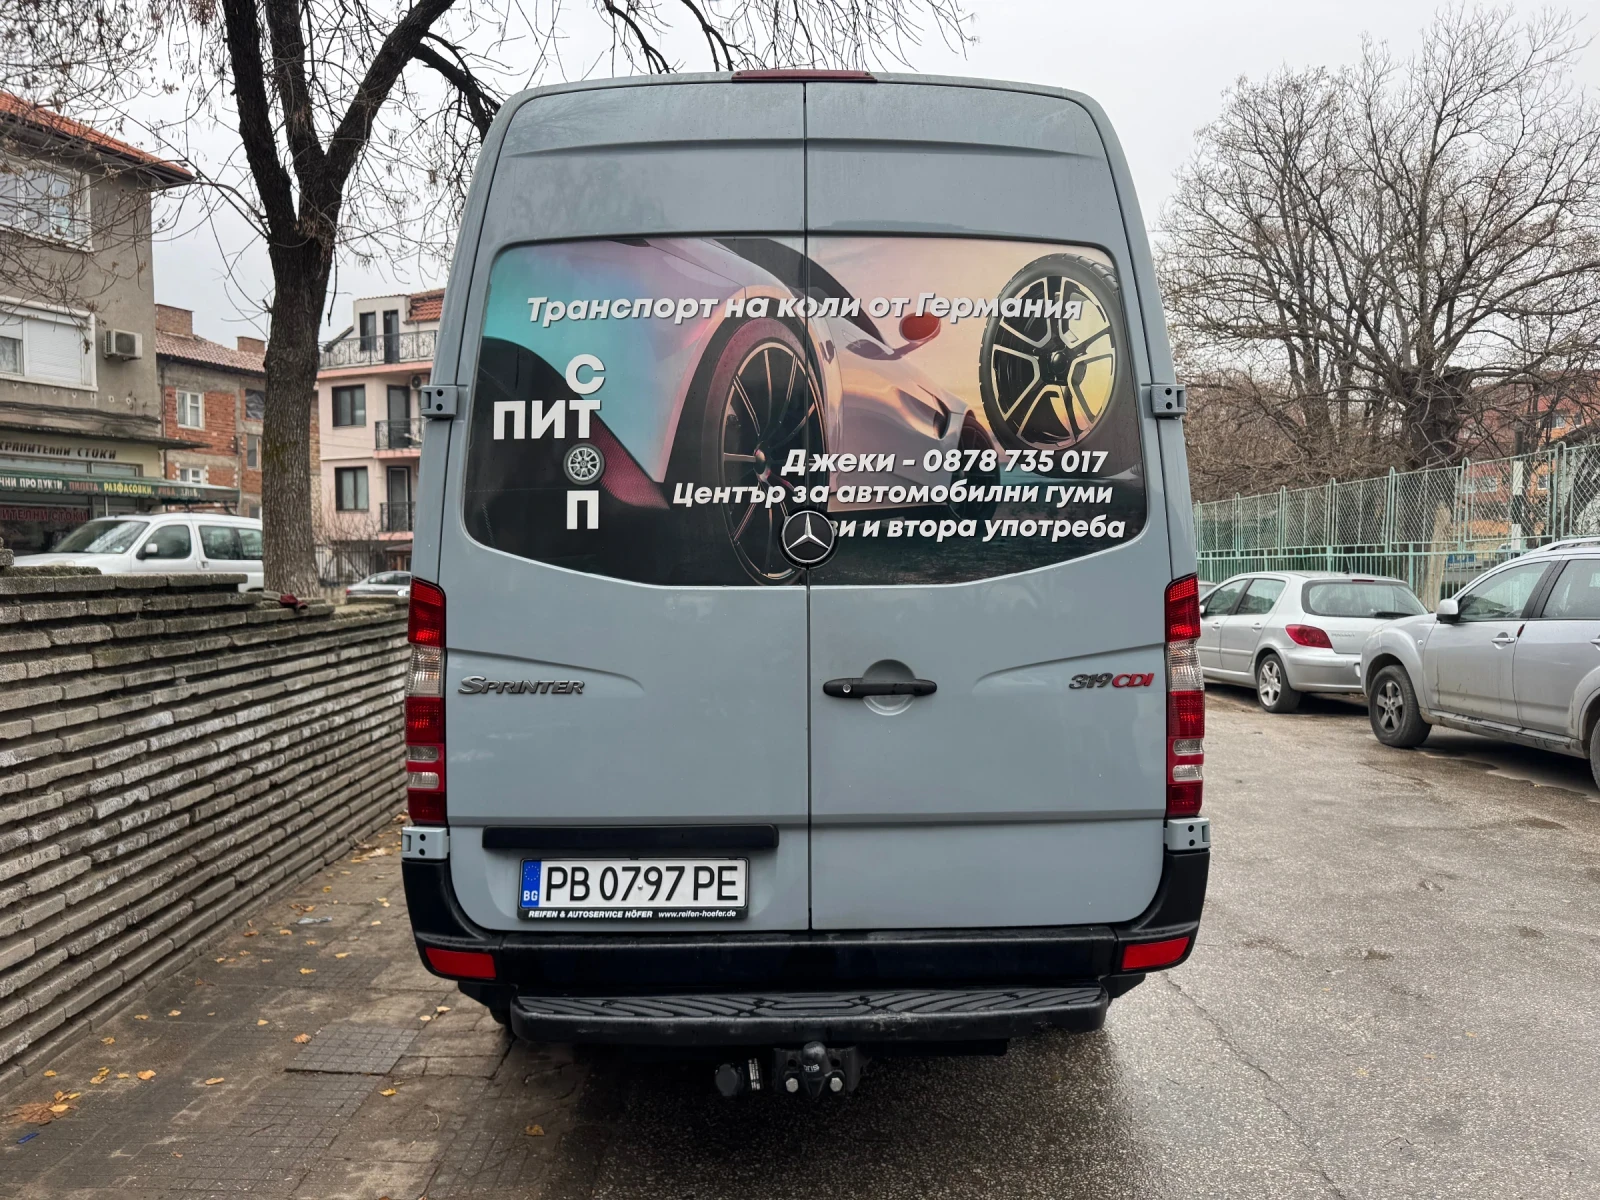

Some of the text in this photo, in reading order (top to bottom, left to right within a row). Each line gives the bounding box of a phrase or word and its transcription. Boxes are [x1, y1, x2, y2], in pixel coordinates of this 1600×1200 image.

[528, 293, 1082, 327] Транспорт на коли от Германия
[493, 400, 601, 440] ПИТ
[77, 447, 117, 460] СТОКИ
[781, 449, 1108, 475] Джеки - 0878 735 017
[673, 479, 1113, 508] Център за автомобилни гуми
[863, 520, 881, 537] и
[887, 519, 977, 542] втора
[982, 514, 1126, 543] употреба
[458, 675, 585, 695] SPRINTER
[523, 890, 538, 901] BG
[546, 866, 738, 901] PB 0797 PE
[529, 909, 736, 918] REIFEN & AUTOSERVICE HÖFER www.reifen-hoefer.de
